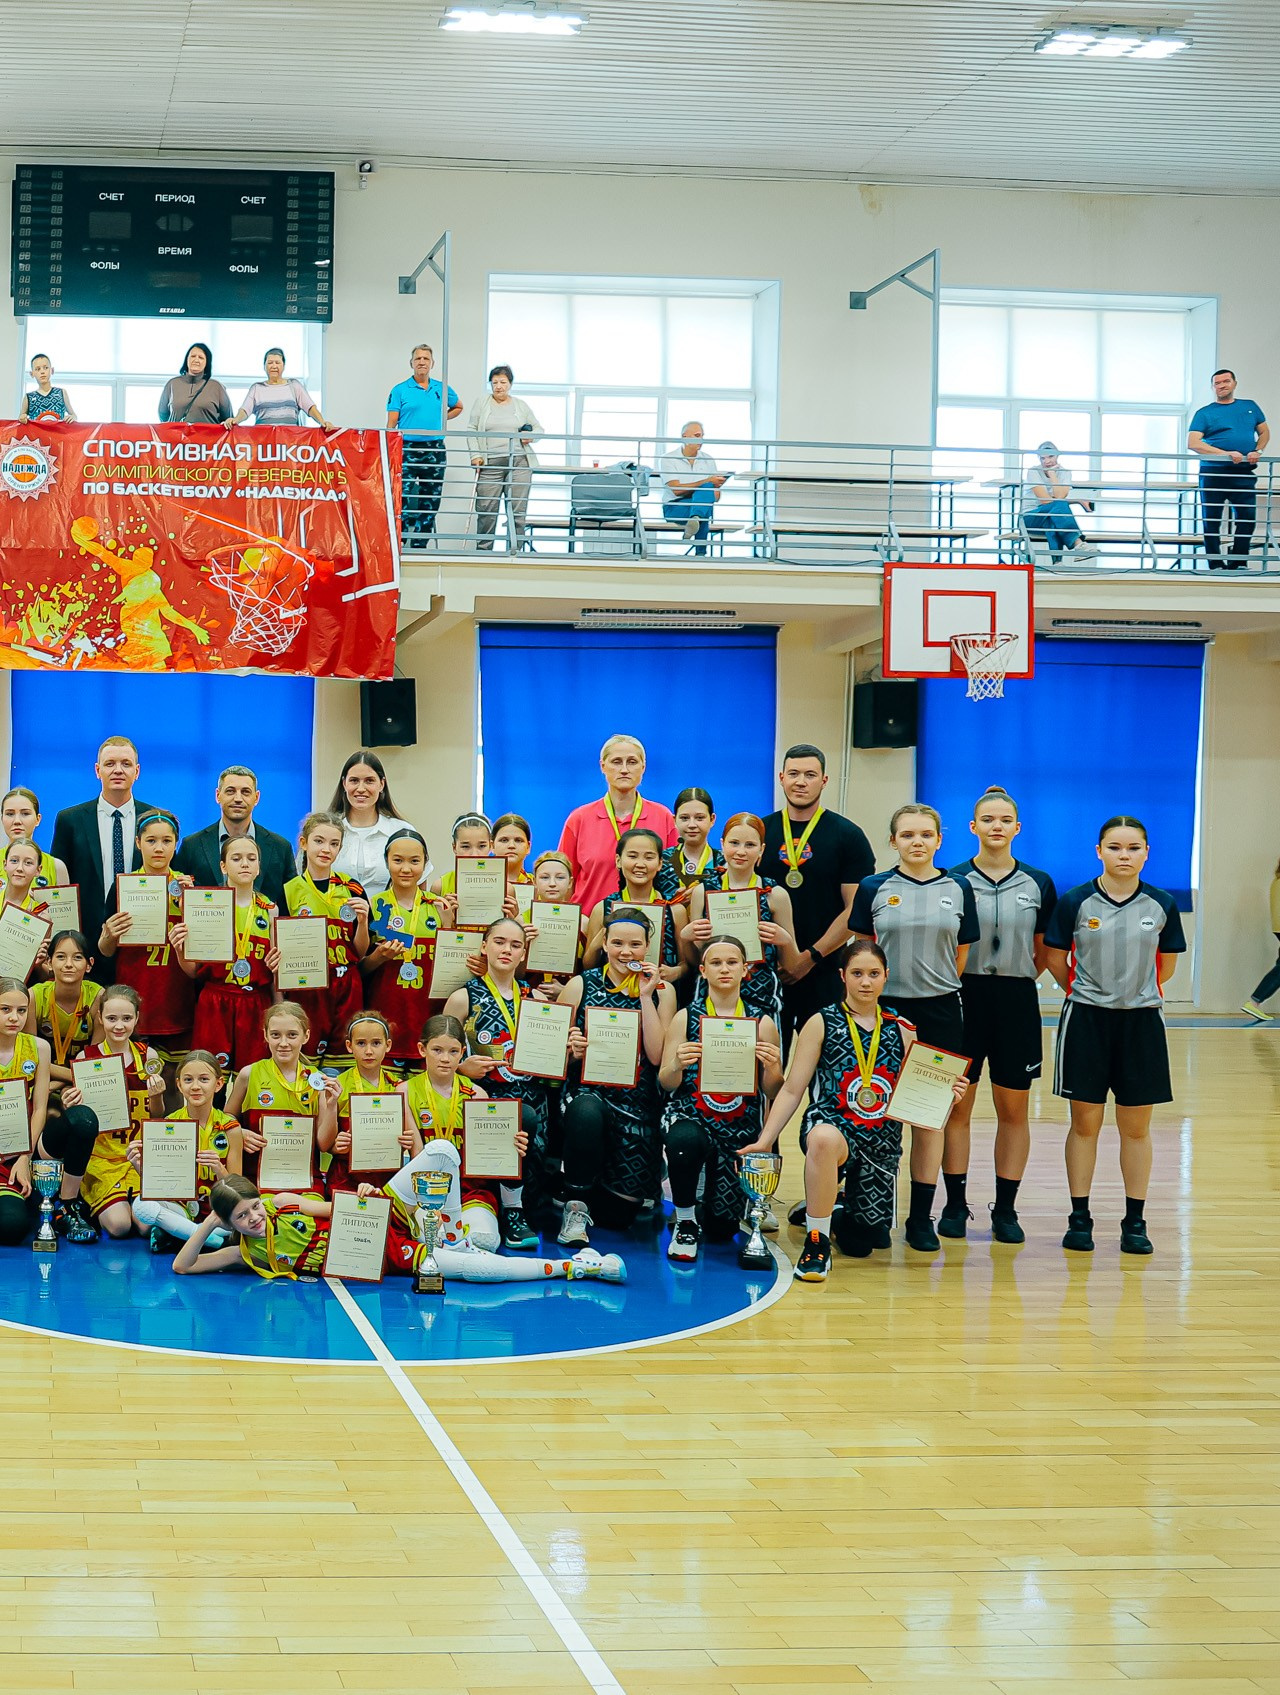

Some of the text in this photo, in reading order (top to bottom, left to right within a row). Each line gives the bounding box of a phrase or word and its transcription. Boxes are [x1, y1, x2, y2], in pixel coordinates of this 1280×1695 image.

[98, 192, 125, 202] СЧЕТ
[155, 193, 195, 205] ПЕРИОД
[240, 196, 266, 205] СЧЕТ
[157, 246, 192, 256] ВРЕМЯ
[90, 261, 120, 271] ФОЛЫ
[229, 264, 259, 274] ФОЛЫ
[83, 440, 346, 467] СПОРТИВНАЯ ШКОЛА
[83, 464, 232, 482] ОЛИМПИЙСКОГО
[236, 468, 316, 484] РЕЗЕРВА
[337, 471, 347, 485] 5
[83, 482, 347, 502] ПО БАСКЕТБОЛУ «НАДЕЖДА»
[464, 876, 498, 885] ДИПЛОМ
[127, 895, 160, 903] ДИПЛОМ
[47, 905, 72, 914] ИПЛОМ
[192, 909, 225, 918] ДИПЛОМ
[717, 911, 751, 920] ДИПЛОМ
[539, 922, 571, 931] ДИПЛОМ
[4, 926, 35, 944] ДИПЛОМ
[147, 944, 170, 967] 27
[527, 1021, 562, 1032] ДИПЛОМ
[595, 1030, 631, 1039] ДИПЛОМ
[710, 1039, 748, 1048] ДИПЛОМ
[912, 1066, 952, 1084] ДИПЛОМ
[84, 1078, 118, 1089] ДИПЛОМ
[359, 1117, 395, 1125] ДИПЛОМ
[474, 1122, 510, 1130] ДИПЛОМ
[270, 1137, 305, 1146] ДИПЛОМ
[151, 1144, 188, 1152] ДИПЛОМ
[340, 1217, 379, 1229] ДИПЛОМ
